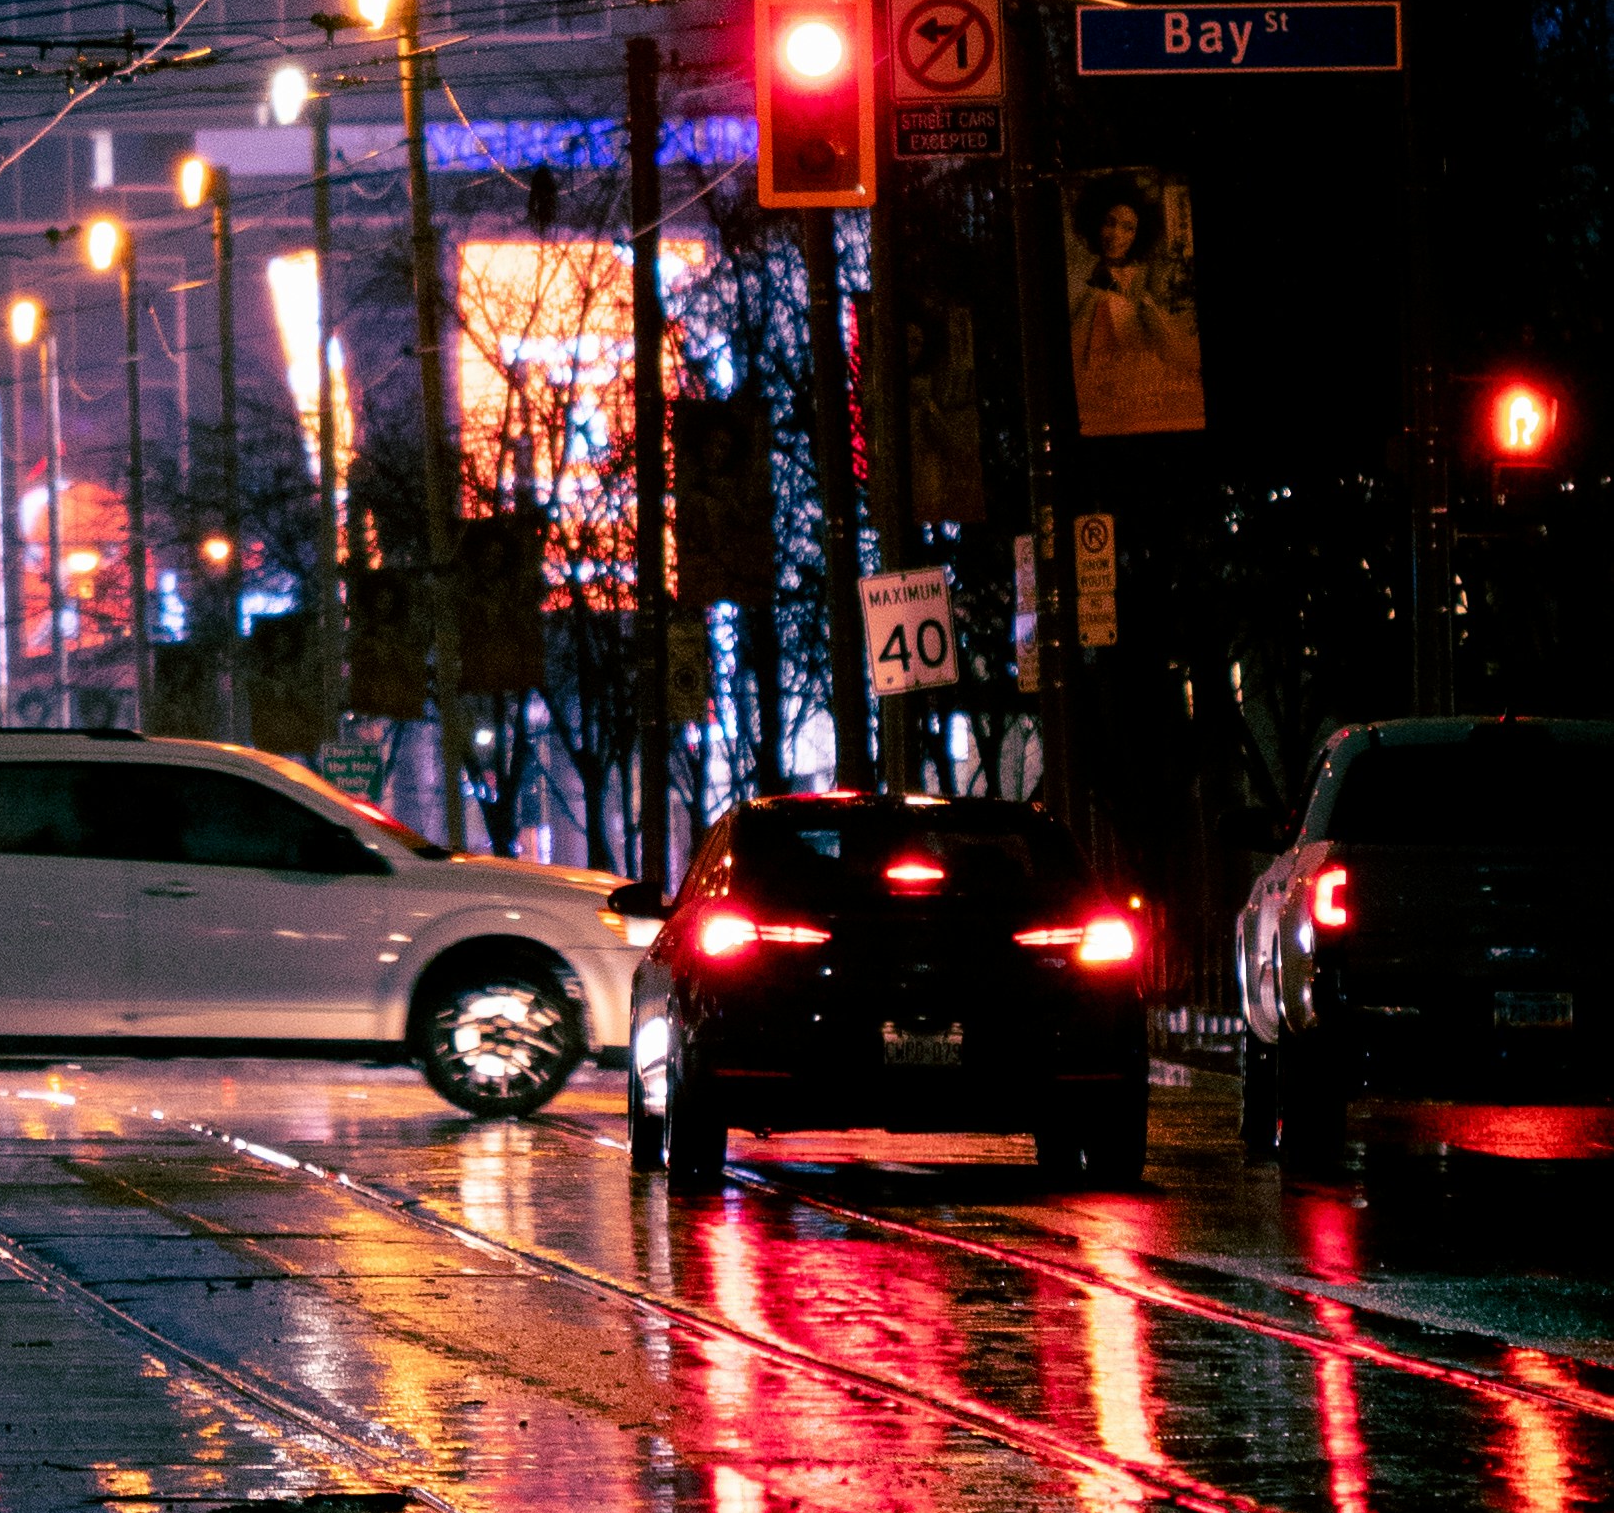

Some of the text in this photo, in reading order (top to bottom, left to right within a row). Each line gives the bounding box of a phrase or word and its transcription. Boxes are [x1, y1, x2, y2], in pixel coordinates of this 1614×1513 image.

[1162, 8, 1290, 65] Bay St
[901, 110, 996, 131] STREET CARS
[910, 131, 988, 151] EXCEPTED
[868, 582, 942, 608] MAXIMUM
[878, 618, 948, 672] 40
